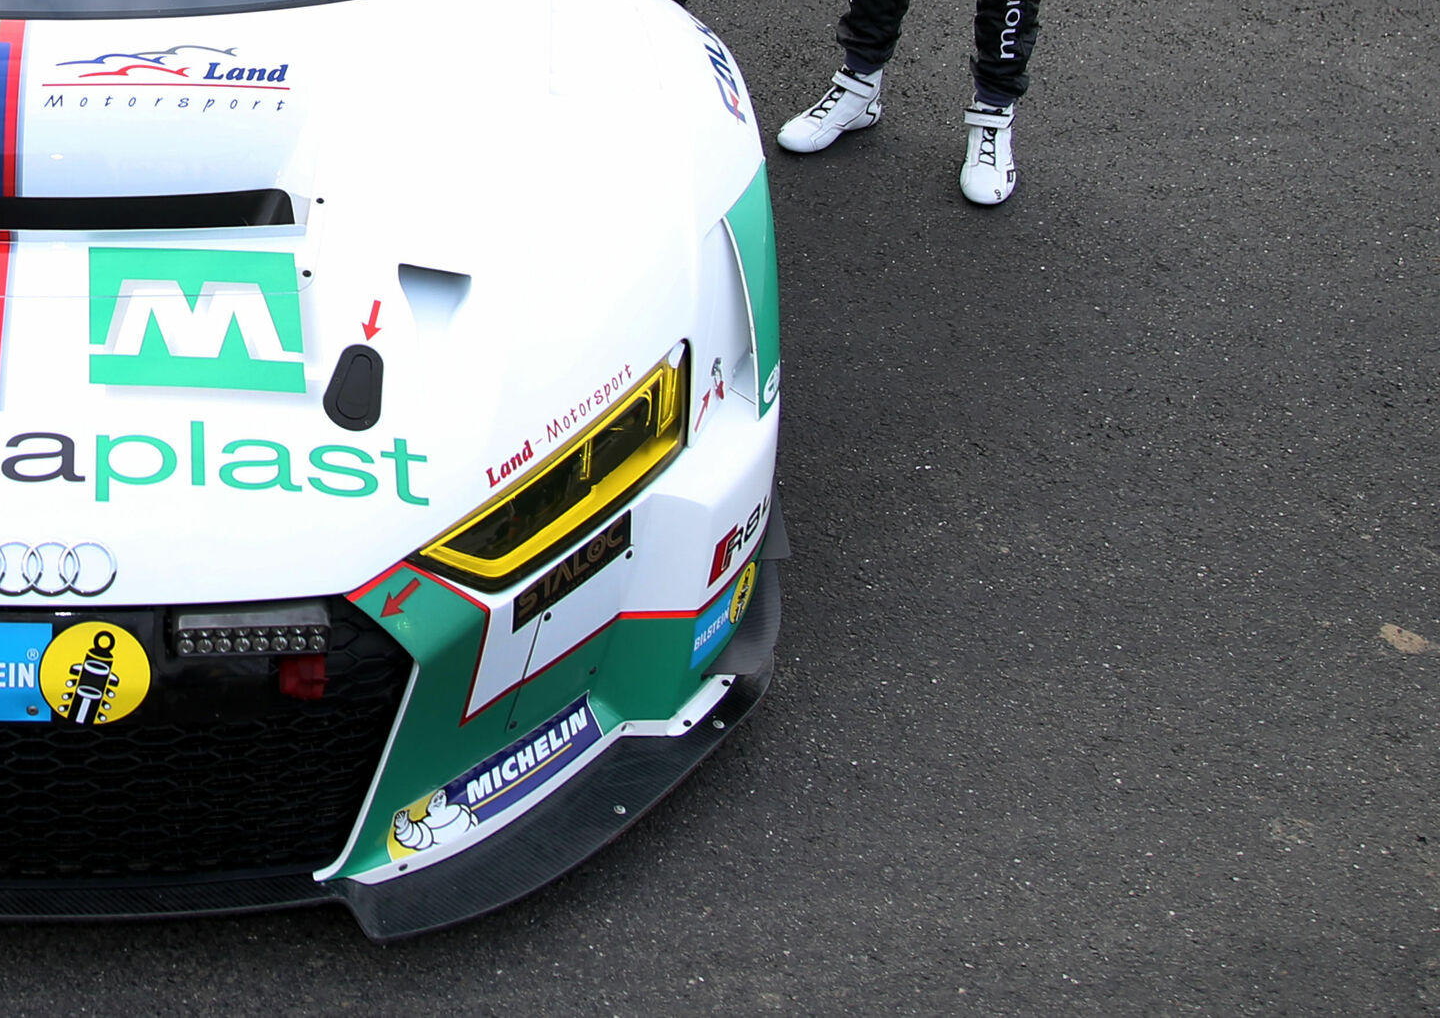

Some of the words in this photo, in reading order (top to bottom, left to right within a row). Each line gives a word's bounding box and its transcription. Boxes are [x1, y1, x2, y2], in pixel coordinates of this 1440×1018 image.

[43, 92, 288, 114] Motorsport
[202, 60, 290, 84] Land
[487, 440, 535, 488] Land
[545, 363, 634, 443] Motorsport
[517, 518, 625, 618] STALOC
[693, 608, 730, 652] BILSTEIN
[465, 706, 591, 805] MICHELIN
